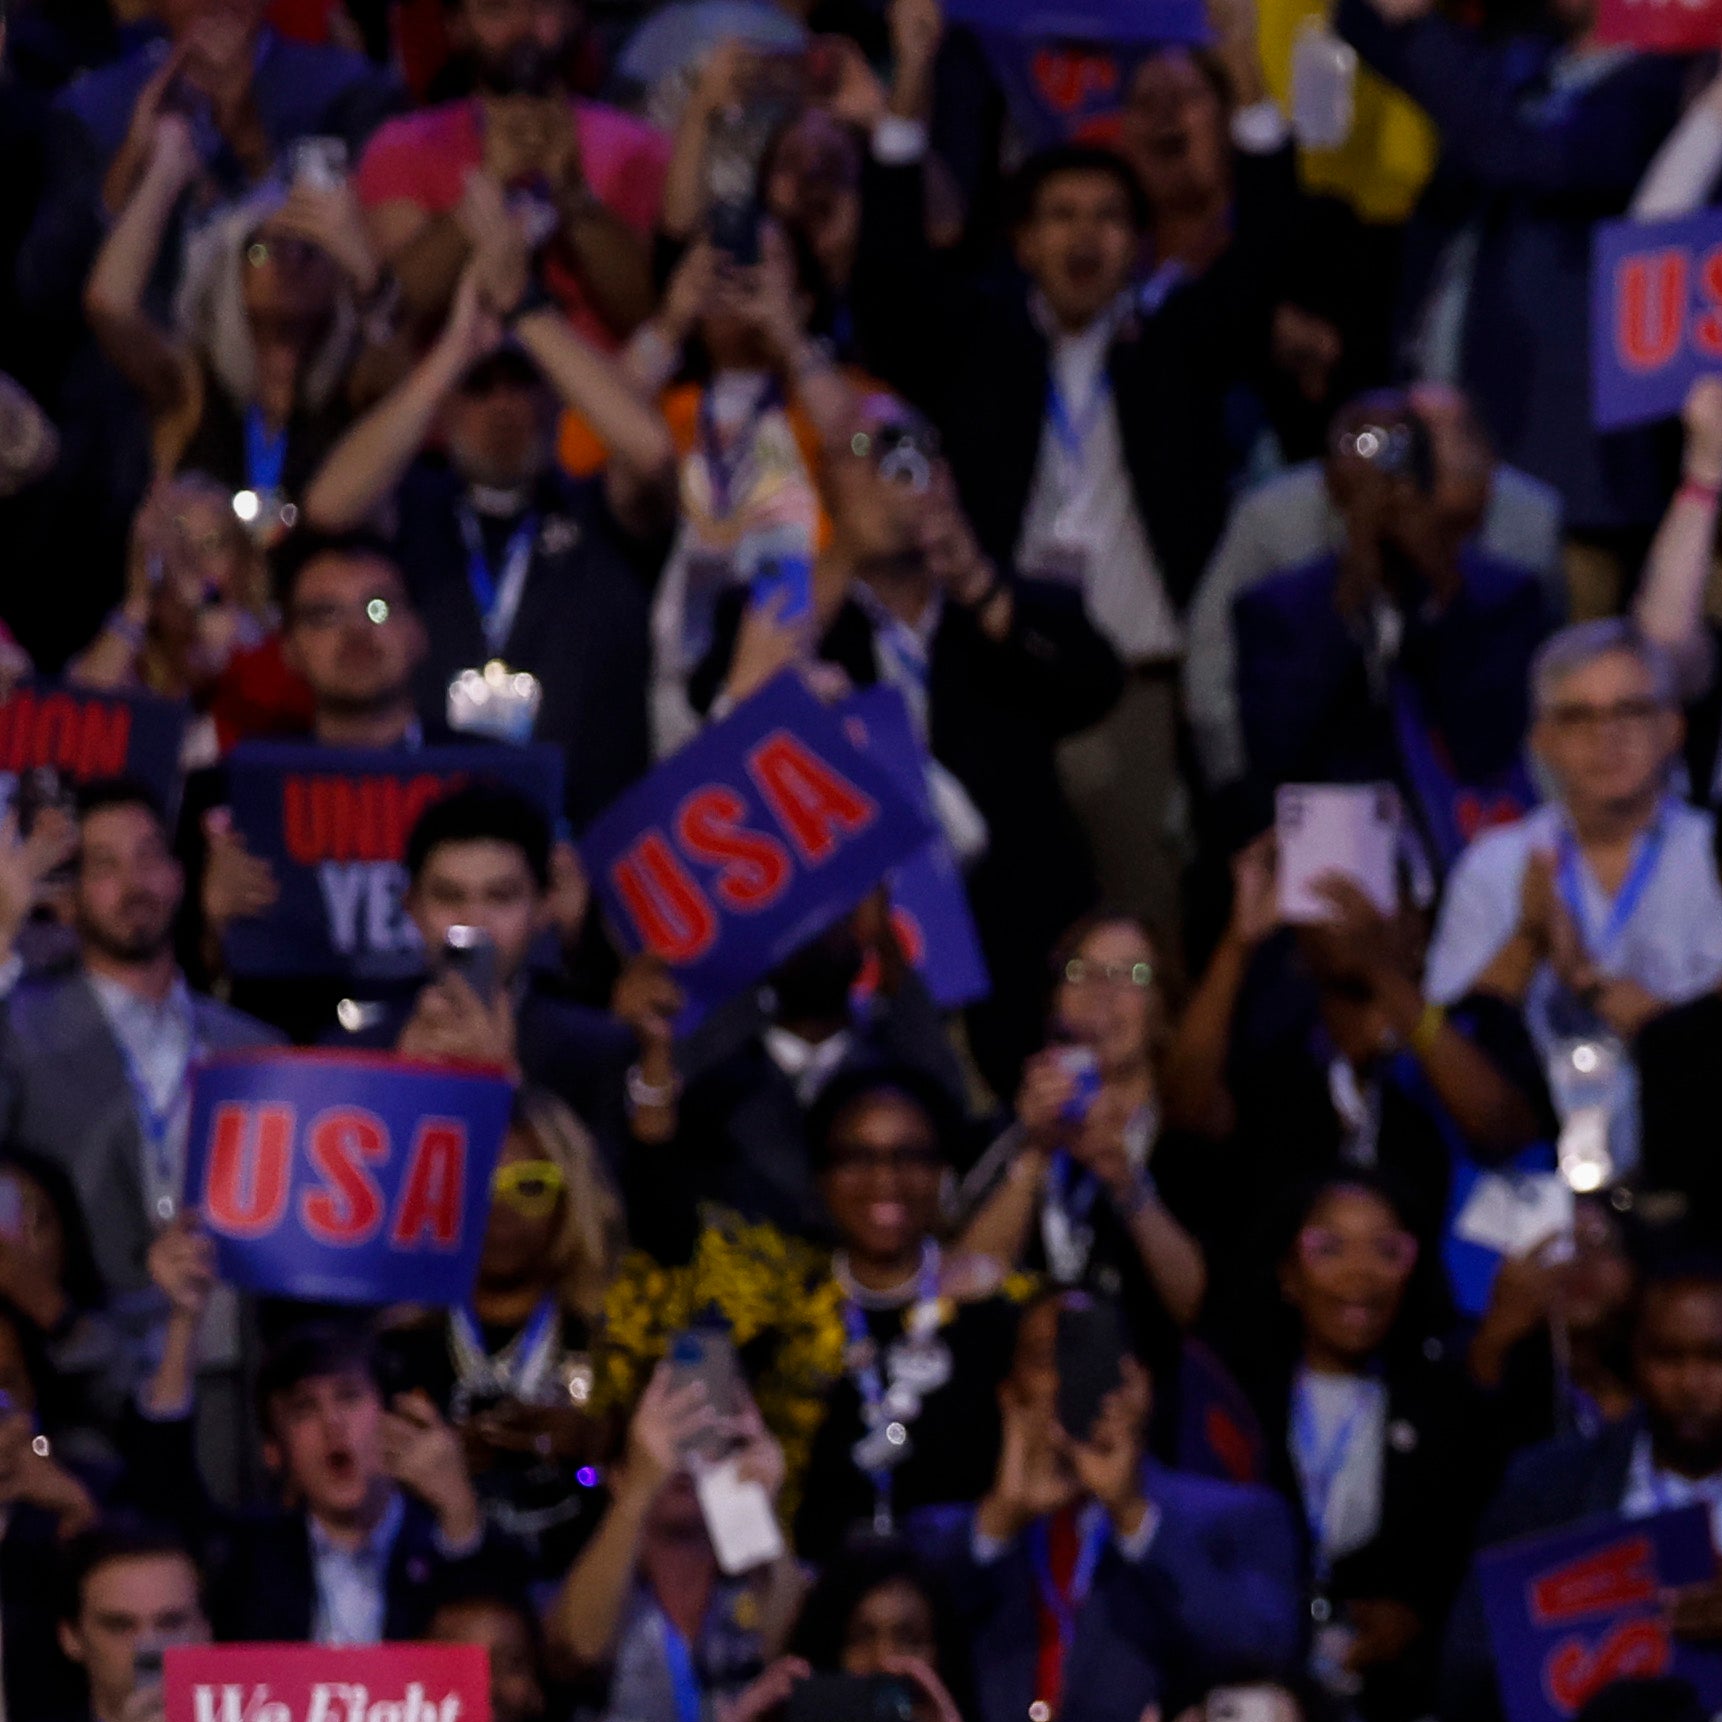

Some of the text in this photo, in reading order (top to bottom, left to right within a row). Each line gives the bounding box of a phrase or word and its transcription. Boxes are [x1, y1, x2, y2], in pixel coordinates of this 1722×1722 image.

[284, 773, 470, 867] UNI
[609, 730, 879, 964] USA
[319, 858, 426, 952] YE
[204, 1102, 469, 1250] USA
[1530, 1536, 1674, 1711] SA
